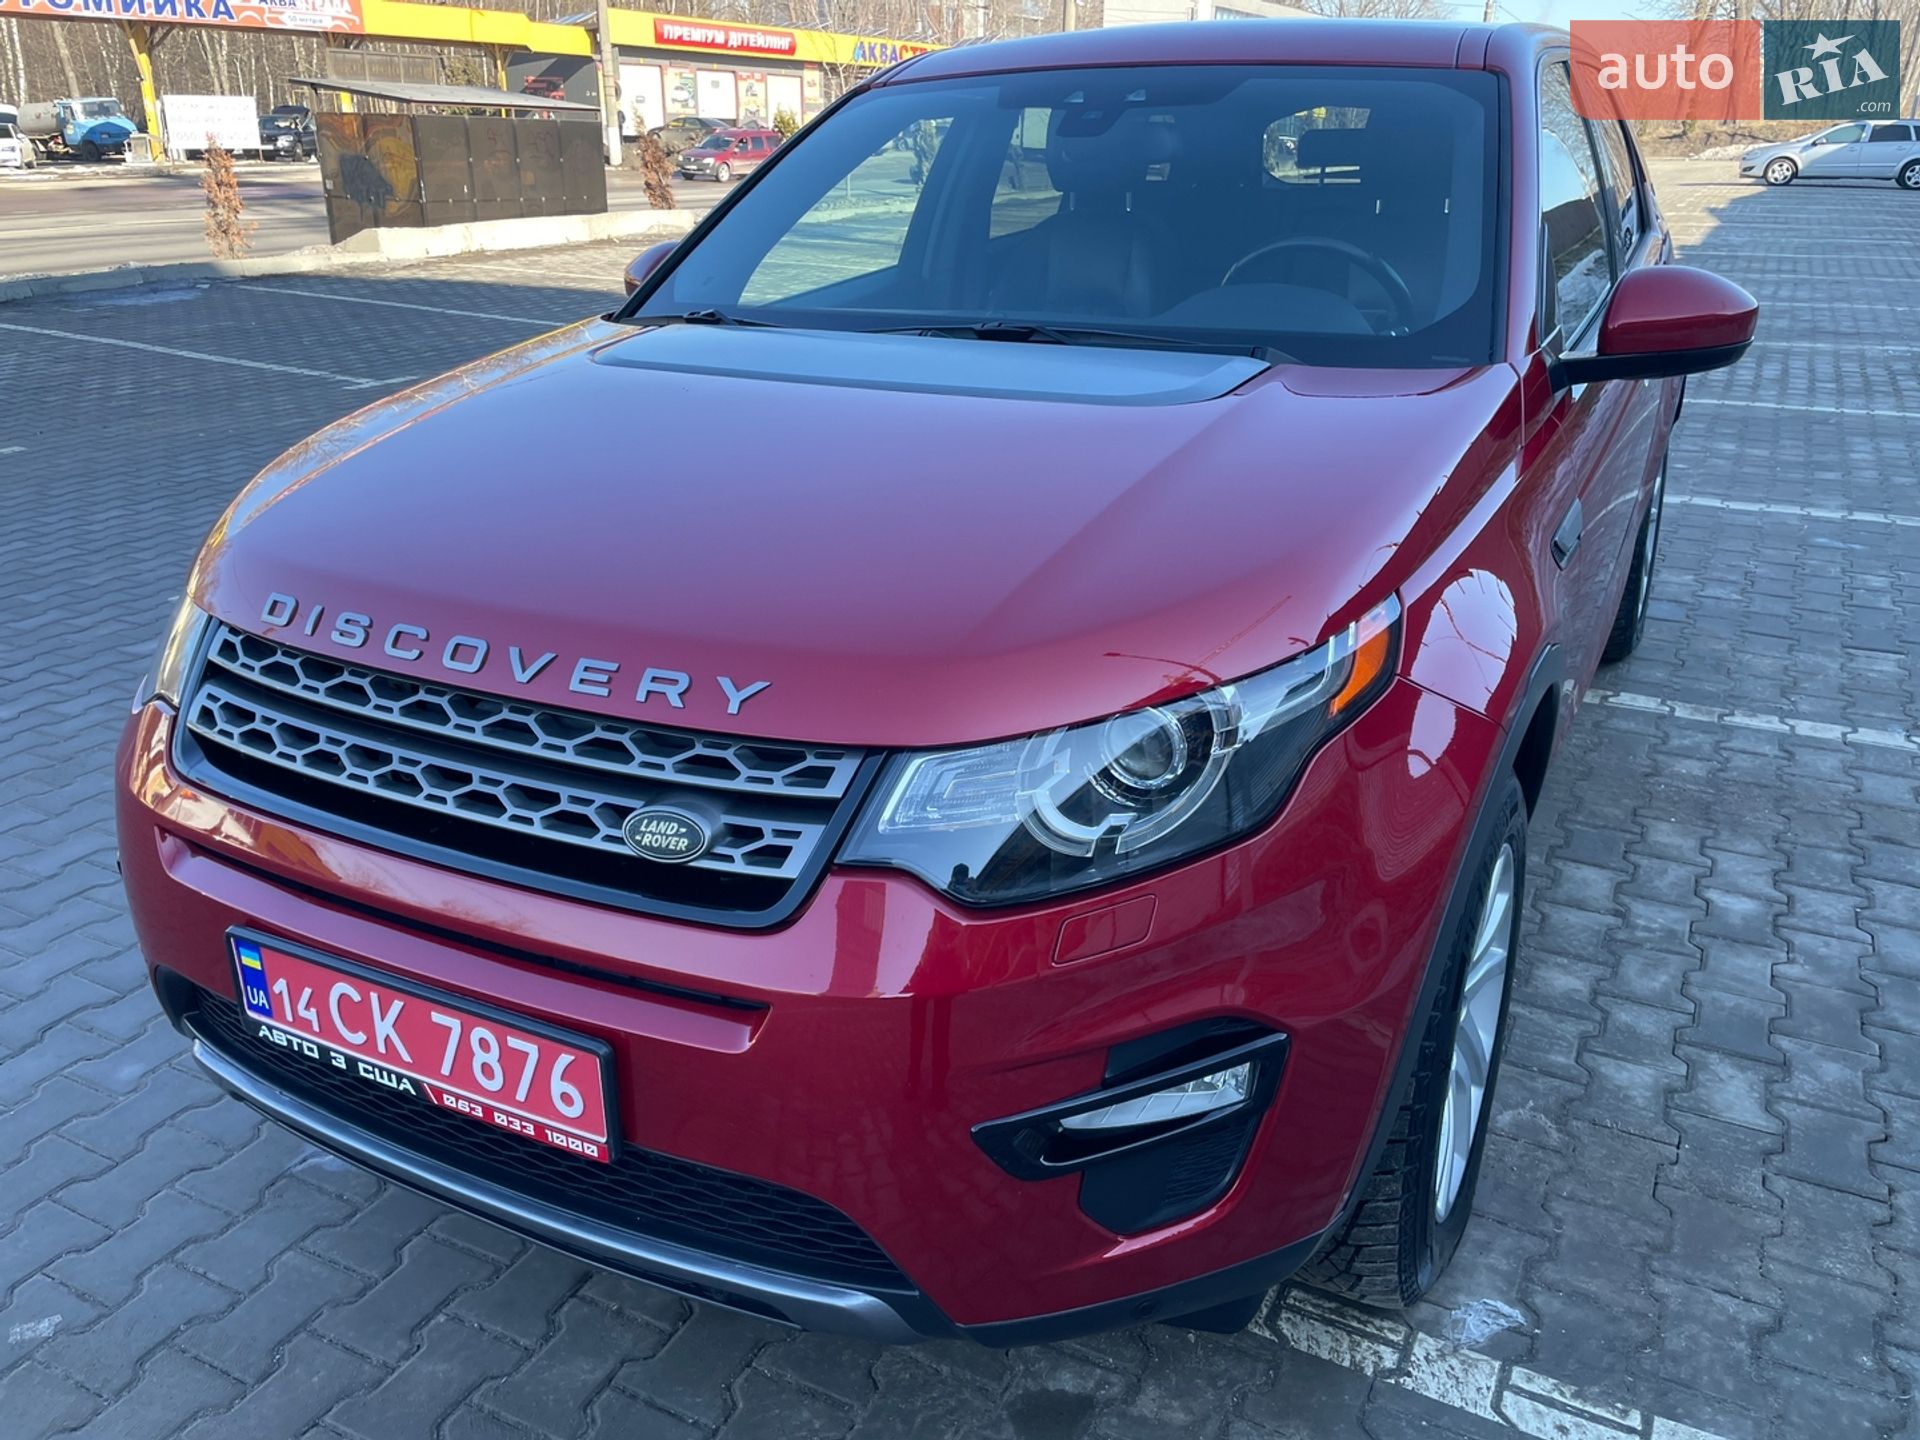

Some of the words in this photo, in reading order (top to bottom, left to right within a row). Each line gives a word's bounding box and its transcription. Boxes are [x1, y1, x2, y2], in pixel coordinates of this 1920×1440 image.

[662, 24, 725, 45] ПРЕМІУМ
[727, 31, 793, 51] ДІТЕЙЛІНГ
[260, 591, 771, 716] DISCOVERY
[247, 983, 269, 1010] UA
[258, 1025, 319, 1059] АВТО
[357, 1061, 417, 1096] США
[430, 1010, 585, 1119] 7876
[442, 1093, 484, 1118] 063
[493, 1110, 535, 1136] 033
[545, 1129, 598, 1157] 1000
